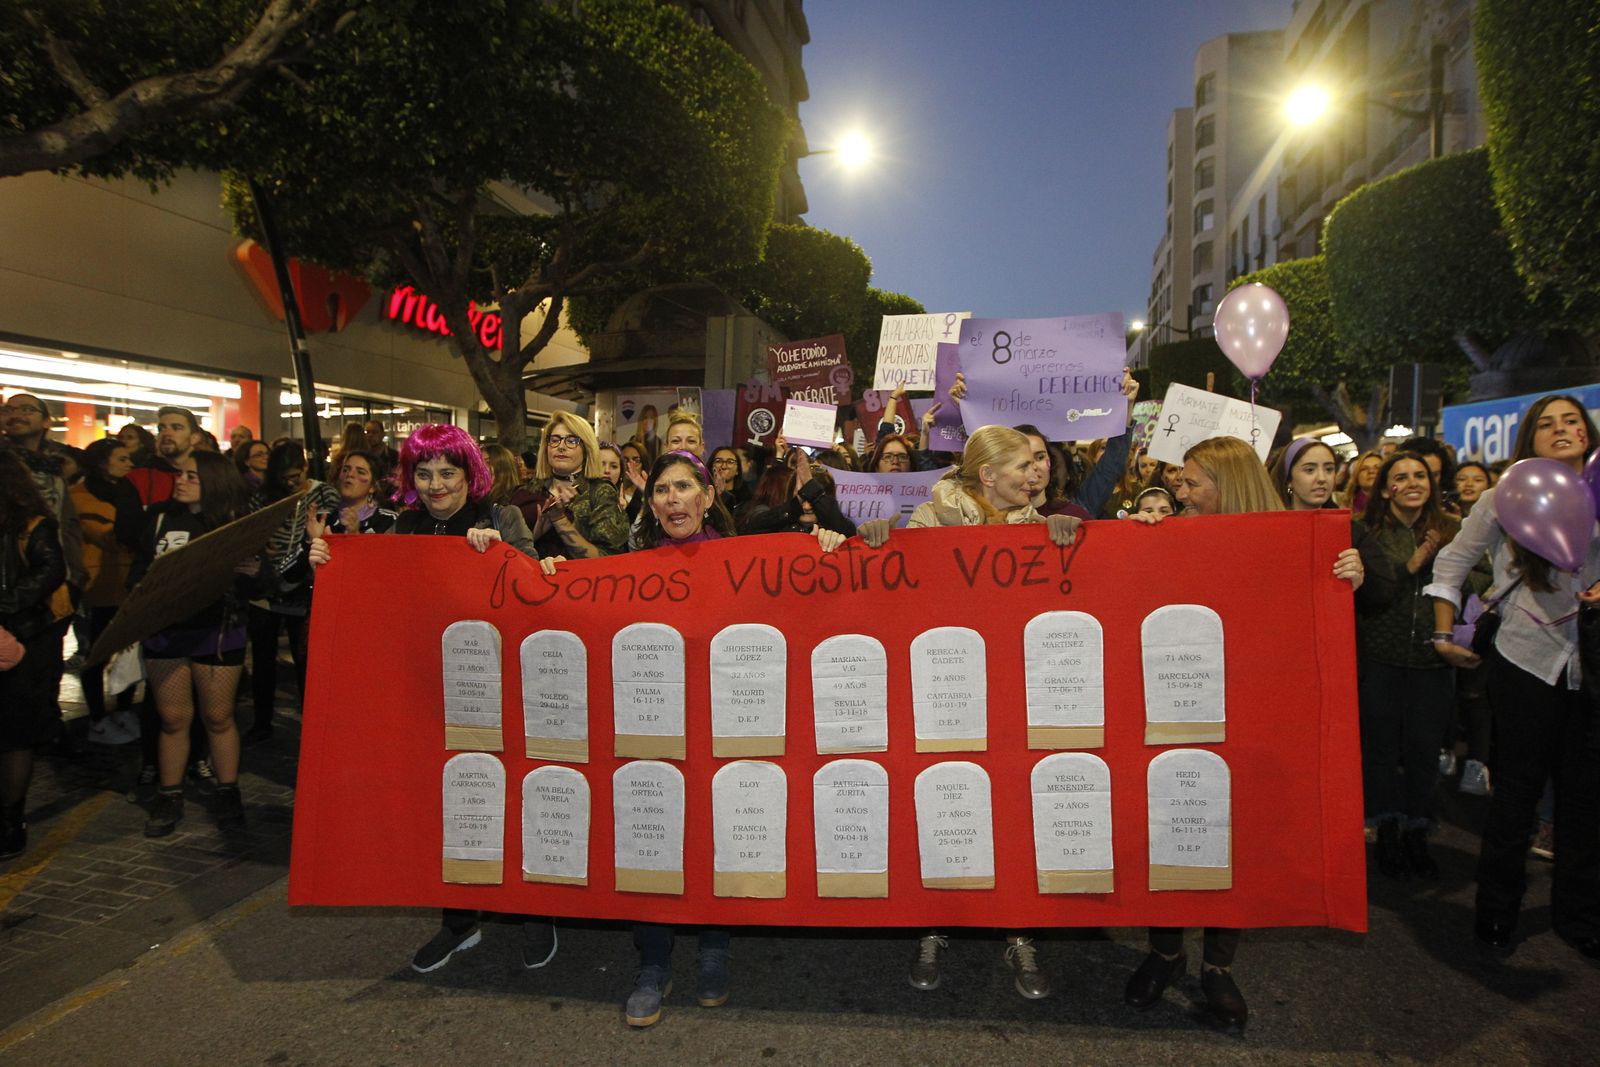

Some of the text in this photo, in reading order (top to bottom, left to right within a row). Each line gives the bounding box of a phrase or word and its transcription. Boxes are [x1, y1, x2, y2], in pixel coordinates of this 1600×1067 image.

[890, 316, 936, 341] PALABRAS
[970, 331, 1032, 364] el 8 de
[801, 343, 827, 361] PODIDO
[879, 343, 930, 365] MACHISTAS
[1013, 348, 1058, 361] marzo
[1019, 361, 1084, 377] queremos
[1039, 375, 1123, 395] DERECHOS
[745, 379, 783, 403] 8M
[790, 385, 840, 405] ODÉRATE
[991, 389, 1054, 412] no flores
[835, 483, 929, 498] TRABAJAR IGUAL
[723, 543, 919, 597] vuestra
[954, 532, 1084, 594] voz!
[1046, 631, 1079, 640] JOSEFA
[452, 647, 491, 656] CONTRERAS
[621, 644, 675, 652] SACRAMENTO
[723, 645, 773, 653] JHOESTHER
[926, 648, 960, 656] REBECA
[636, 653, 659, 661] ROCA
[1165, 653, 1202, 662] 71 AÑOS
[1058, 657, 1081, 666] AÑOS
[468, 664, 485, 672] AÑOS
[549, 667, 569, 675] AÑOS
[643, 670, 665, 678] AÑOS
[743, 671, 766, 679] AÑOS
[943, 674, 966, 682] AÑOS
[1158, 672, 1210, 680] BARCELONA
[456, 681, 487, 689] GRANADA
[844, 681, 867, 689] AÑOS
[1044, 677, 1085, 685] GRANADA
[1167, 681, 1203, 689] 15-09-18
[540, 693, 569, 701] TOLEDO
[926, 692, 972, 700] CANTABRIA
[459, 772, 489, 780] MARTINA
[1175, 771, 1200, 779] HEIDI
[451, 780, 496, 788] CARRASCOSA
[630, 780, 655, 788] MARÍA
[833, 780, 869, 788] PATRICIA
[936, 783, 970, 792] RAQUEL
[535, 786, 550, 794] ANA
[631, 789, 664, 797] ORTEGA
[836, 789, 866, 797] ZURITA
[467, 797, 486, 805] AÑOS
[541, 795, 570, 803] VARELA
[1183, 798, 1207, 807] AÑOS
[1053, 801, 1089, 810] 29 AÑOS
[631, 806, 665, 814] 48 AÑOS
[735, 806, 765, 815] 6 AÑOS
[834, 807, 869, 815] 40 AÑOS
[949, 809, 971, 818] AÑOS
[551, 811, 571, 820] AÑOS
[1052, 820, 1093, 828] ASTURIAS
[1171, 817, 1206, 825] MADRID
[631, 823, 665, 832] ALMERÍA
[835, 825, 867, 833] GIRONA
[1171, 826, 1207, 834] 16-11-18
[543, 828, 574, 838] CORUÑA
[631, 832, 665, 840] 30-03-18
[933, 828, 977, 837] ZARAGOZA
[732, 833, 767, 841] 02-10-18
